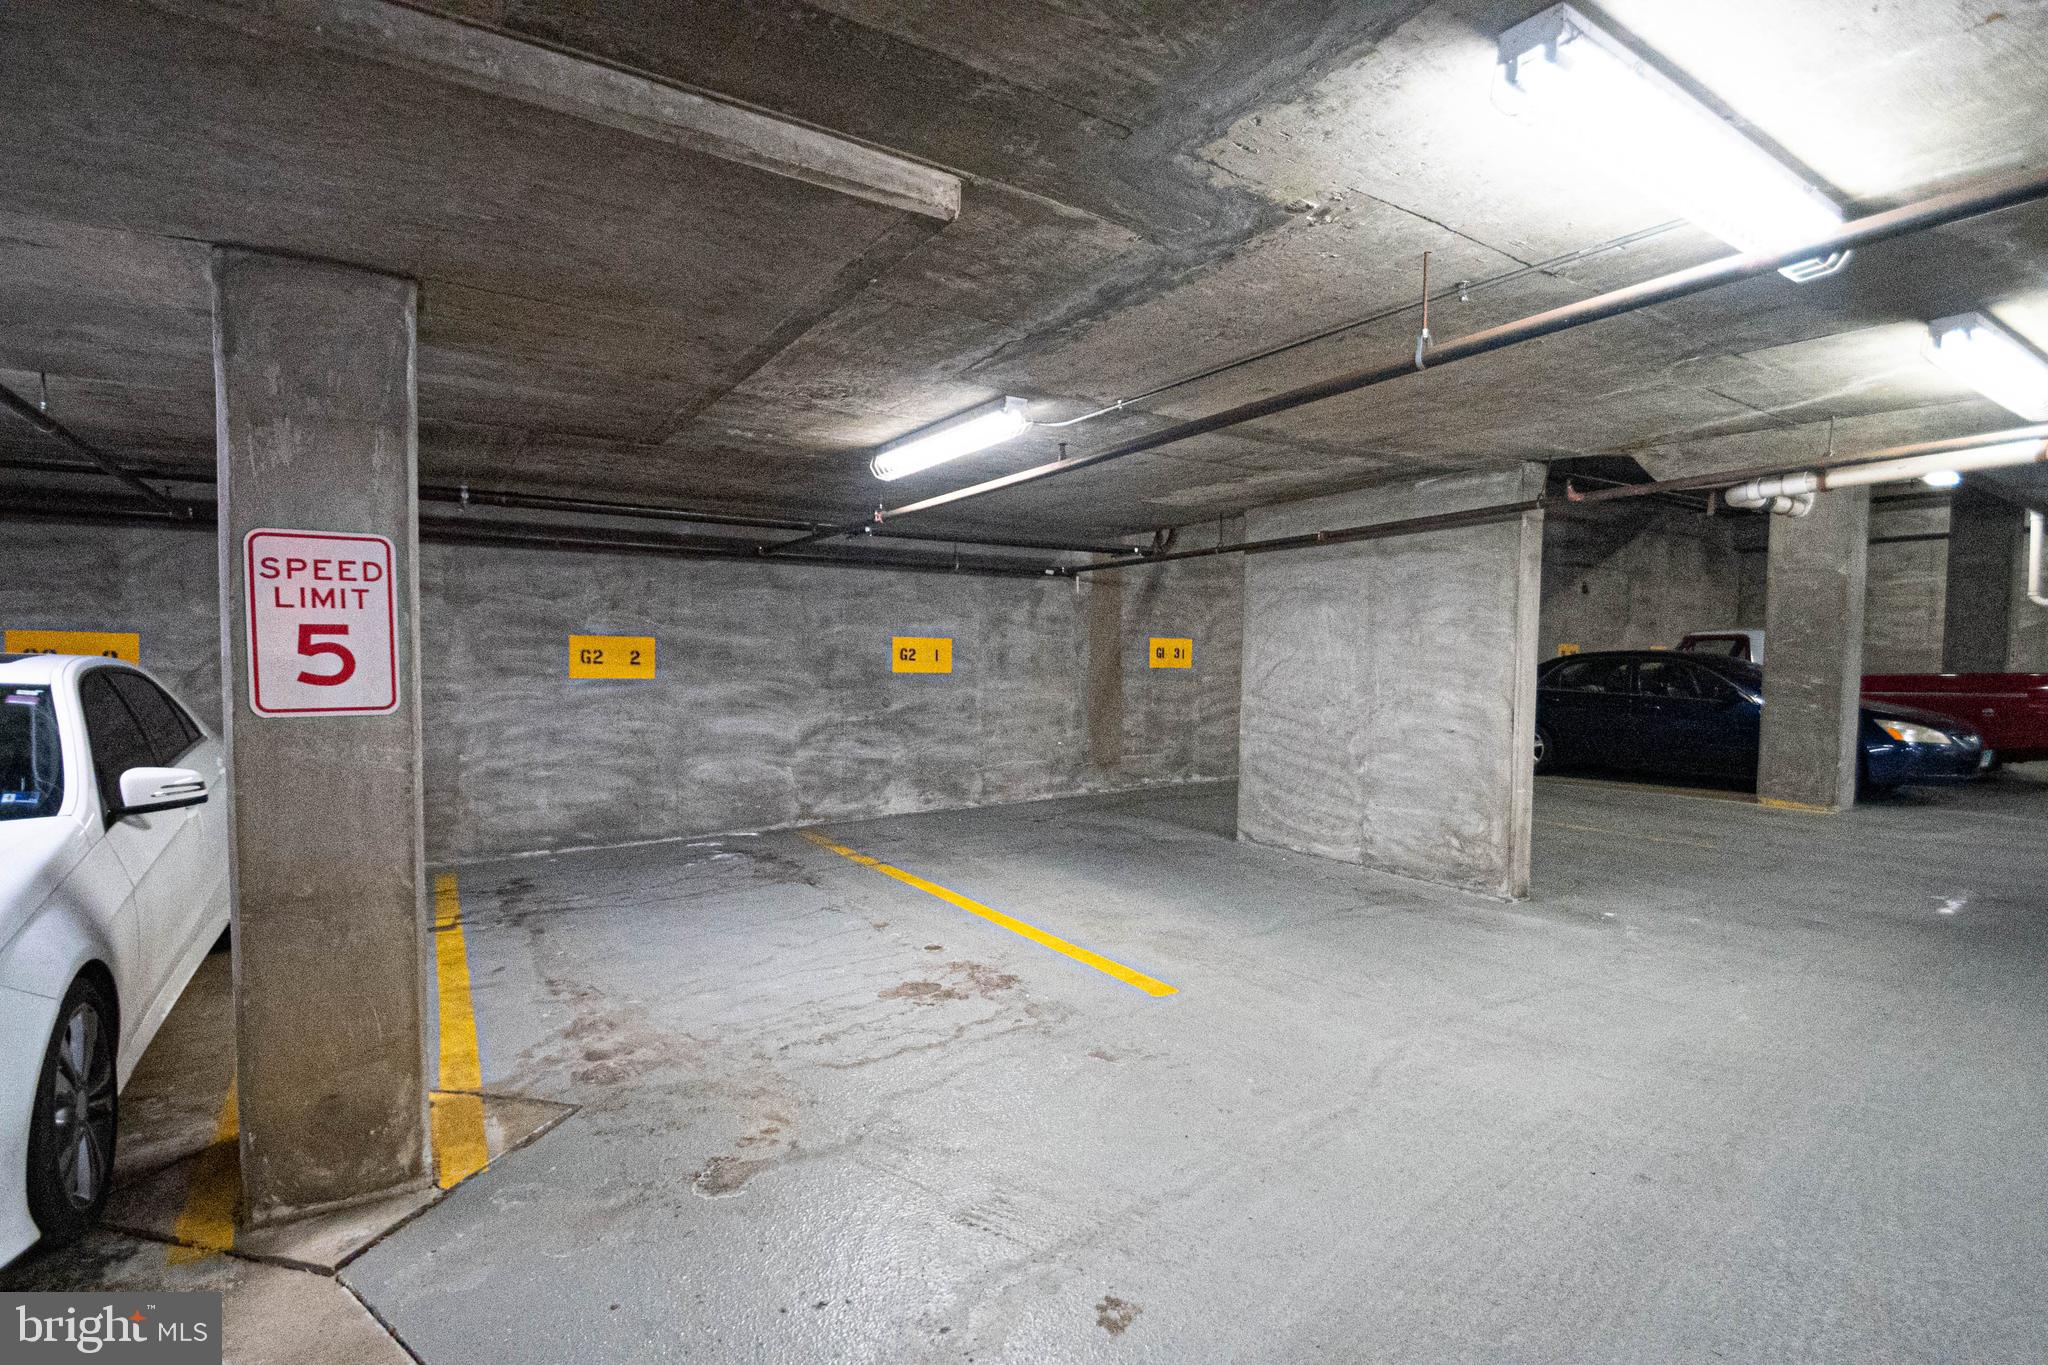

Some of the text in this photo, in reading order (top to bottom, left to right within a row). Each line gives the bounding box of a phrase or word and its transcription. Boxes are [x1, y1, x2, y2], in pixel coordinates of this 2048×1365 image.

[259, 557, 383, 582] SPEED
[274, 586, 370, 610] LIMIT
[297, 624, 356, 686] 5
[580, 649, 641, 665] G2 2
[900, 648, 916, 662] G2
